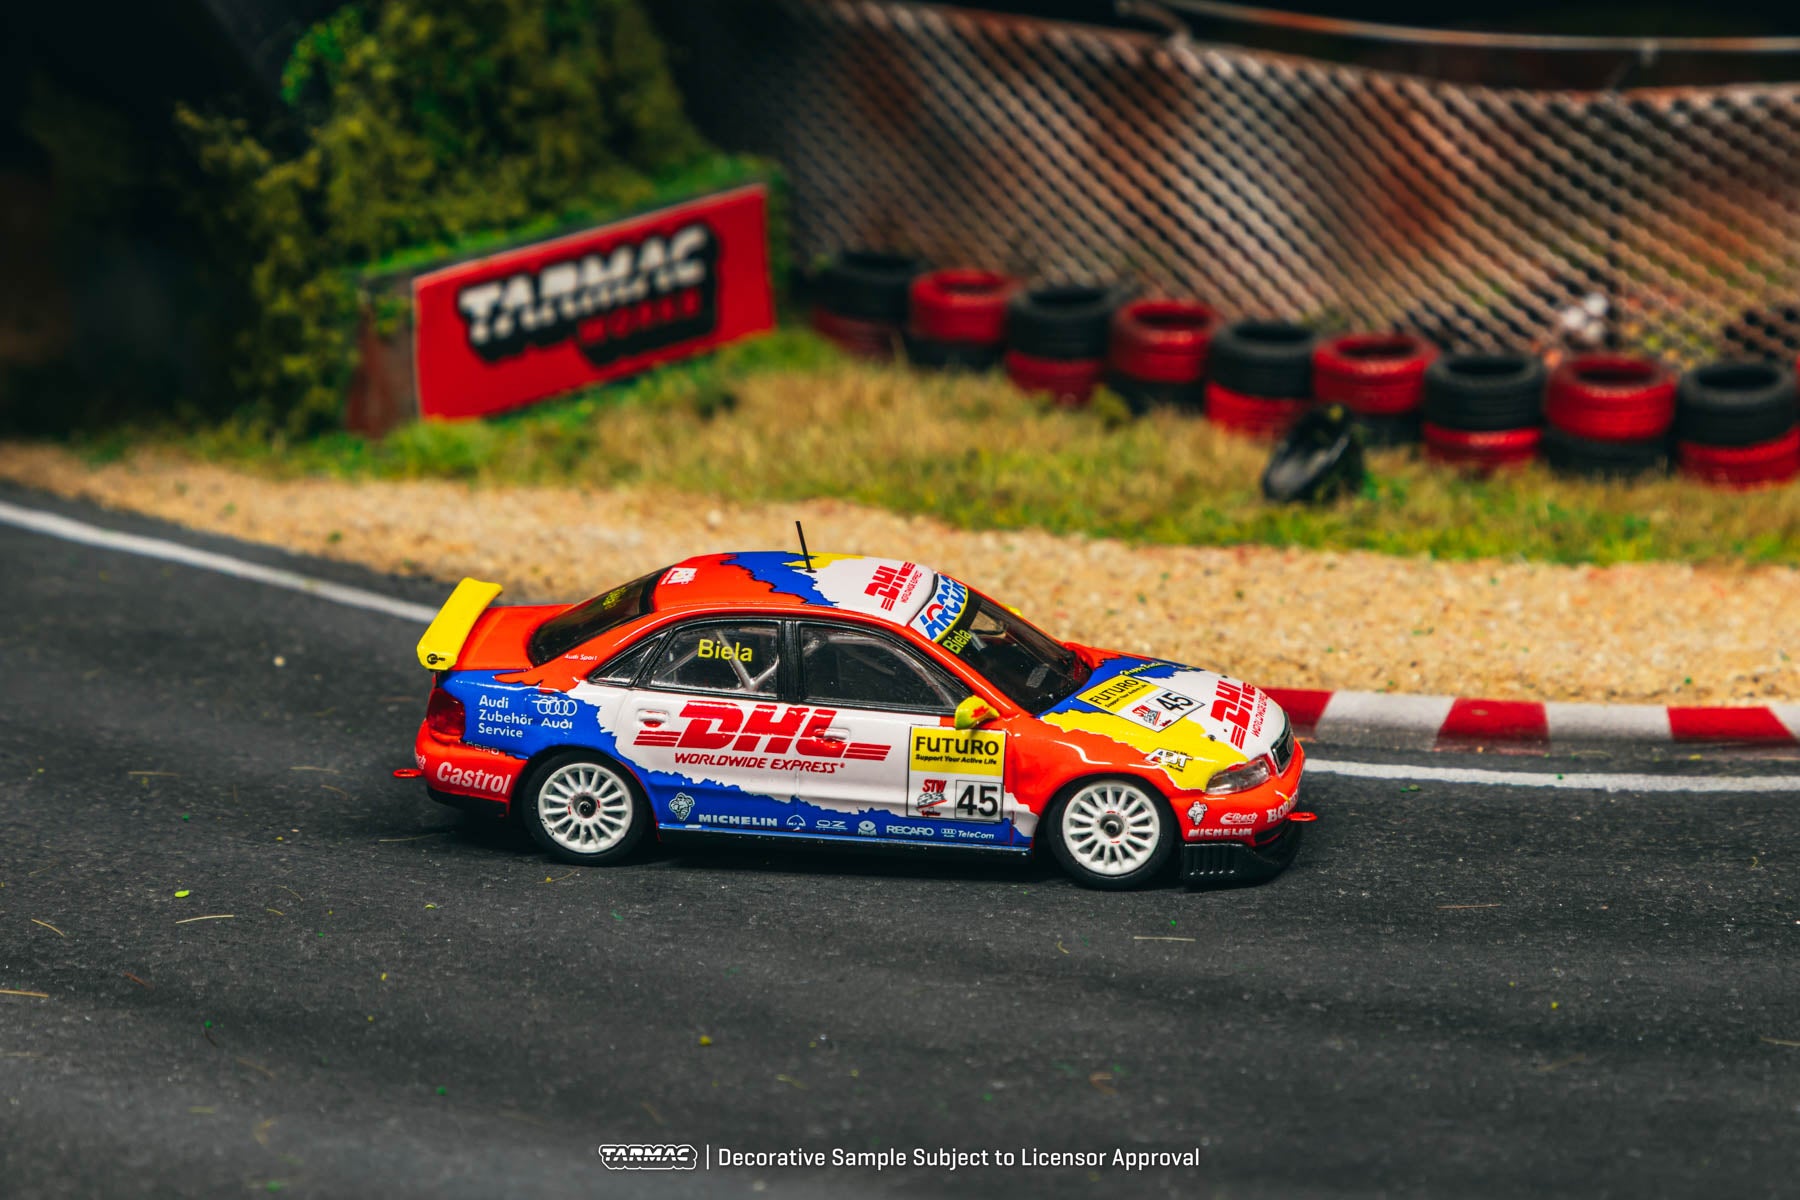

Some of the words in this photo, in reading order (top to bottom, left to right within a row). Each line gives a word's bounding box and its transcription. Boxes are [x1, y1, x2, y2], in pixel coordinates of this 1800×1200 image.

[459, 224, 705, 343] TARMAC
[942, 629, 972, 655] Biela
[698, 639, 753, 662] Biela
[1089, 679, 1139, 704] FUTURO
[479, 695, 509, 709] Audi
[1156, 692, 1194, 711] 45
[478, 709, 533, 725] Zubehör
[541, 718, 572, 729] Audi
[478, 723, 523, 738] Service
[677, 700, 848, 758] DHL
[915, 736, 999, 756] FUTURO
[674, 752, 765, 769] WORLDWIDE
[915, 754, 943, 762] Support
[436, 761, 512, 794] Castrol
[922, 779, 947, 793] STW
[956, 784, 998, 817] 45
[698, 814, 778, 827] MICHELIN
[886, 825, 935, 836] RECARO
[958, 830, 994, 839] TeleCom
[1188, 828, 1252, 838] MICHELIN
